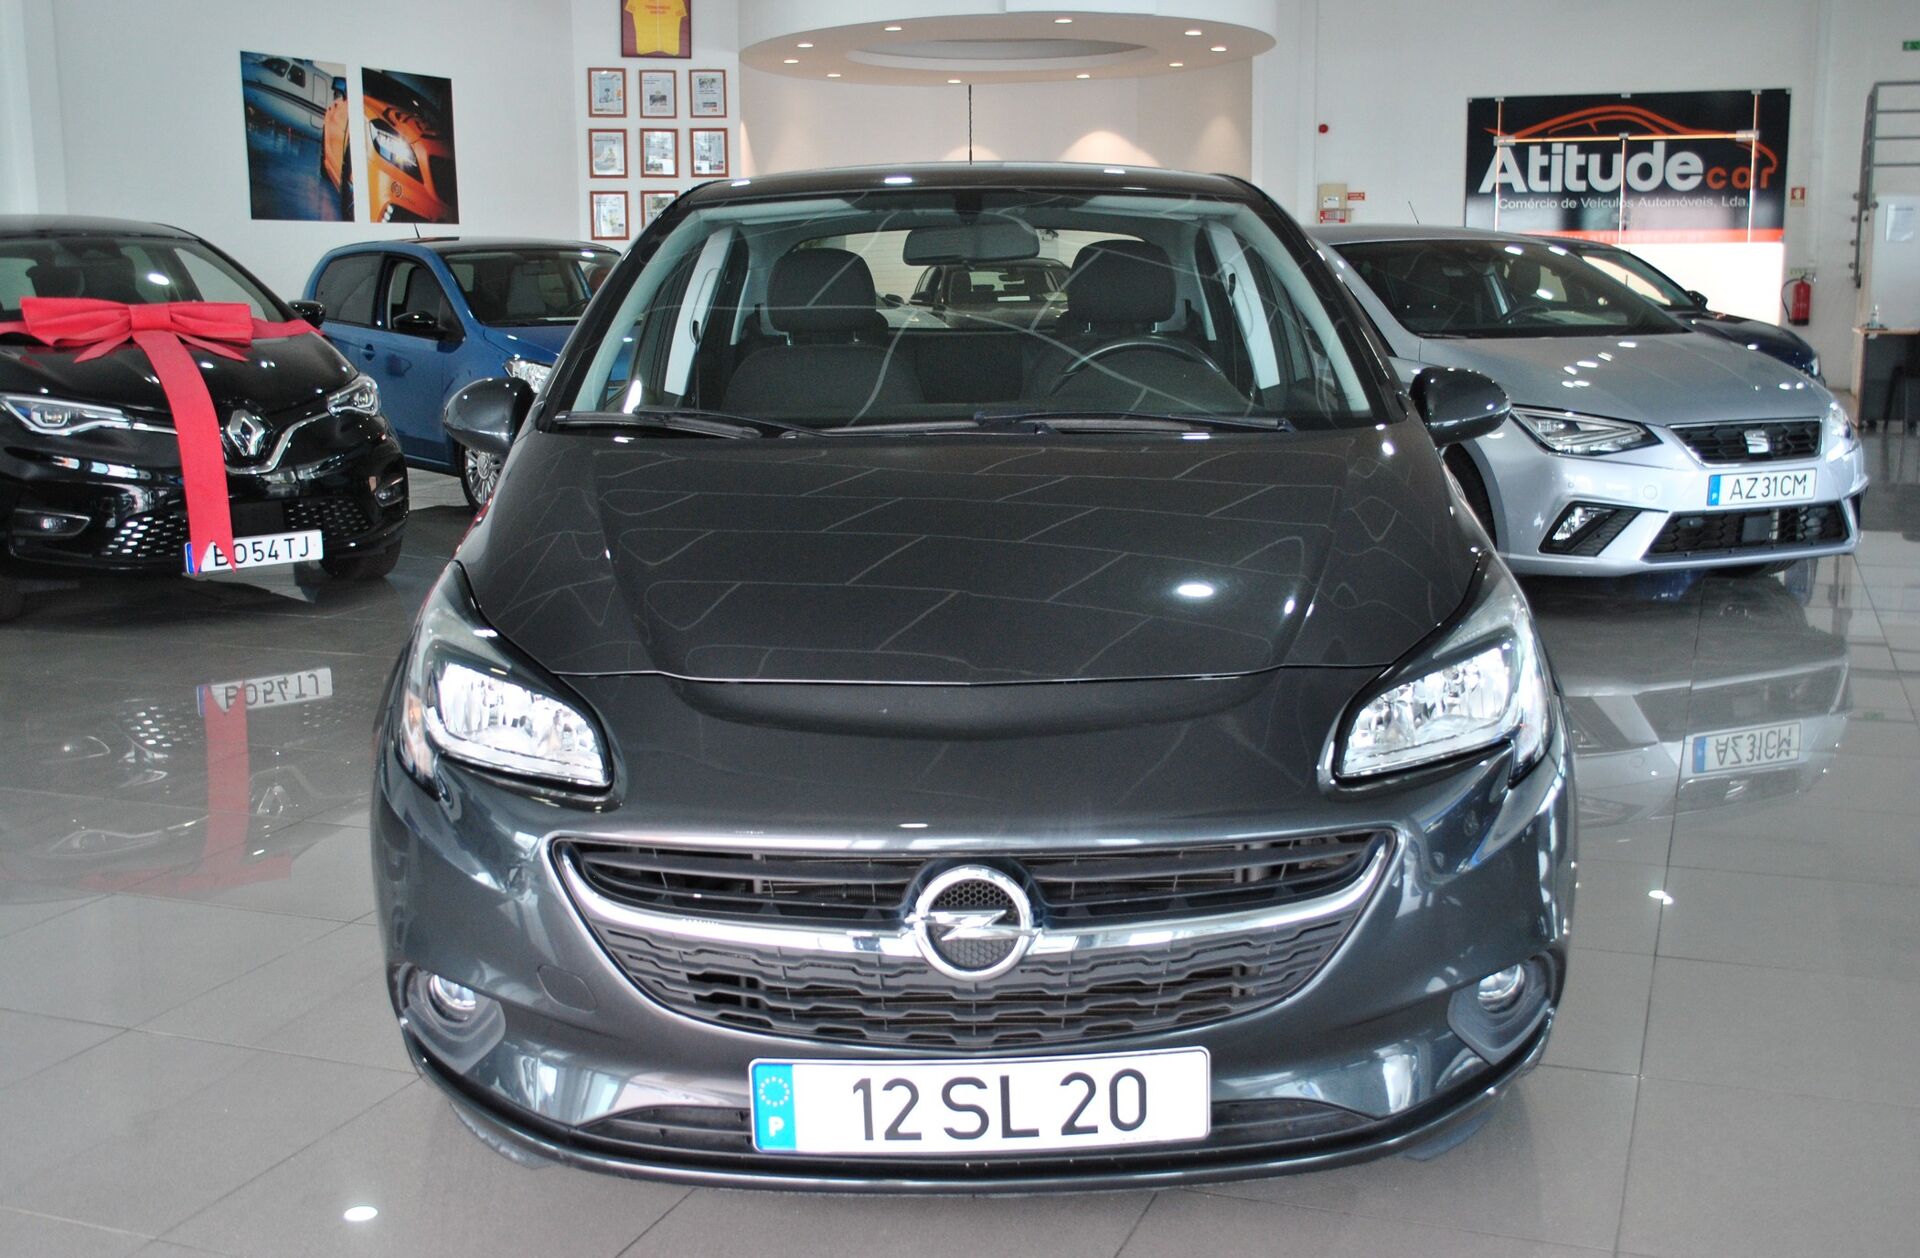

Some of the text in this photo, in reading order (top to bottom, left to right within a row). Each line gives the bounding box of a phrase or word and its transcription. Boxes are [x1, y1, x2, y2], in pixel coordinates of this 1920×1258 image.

[1478, 141, 1704, 193] Atitude
[1499, 197, 1558, 209] Comércio
[1560, 197, 1577, 209] de
[768, 1116, 785, 1137] P
